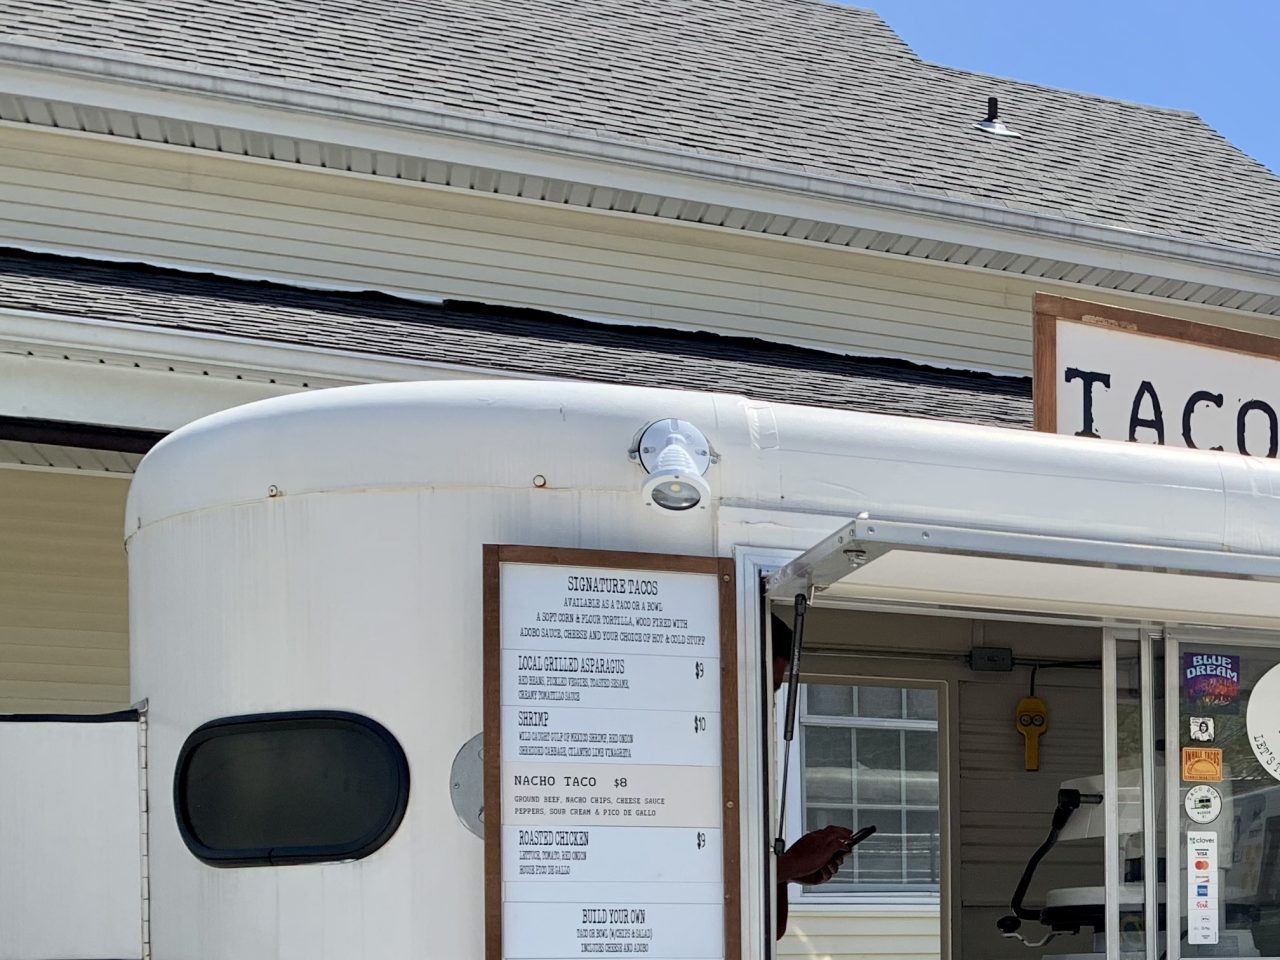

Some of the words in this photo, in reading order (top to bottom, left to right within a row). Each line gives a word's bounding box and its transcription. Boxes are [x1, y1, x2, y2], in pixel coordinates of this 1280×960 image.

[1064, 366, 1279, 459] TACO
[568, 576, 626, 594] SIGNATURE
[628, 579, 658, 596] TACOS
[564, 597, 600, 609] AVAILABLE
[601, 599, 609, 610] AS
[611, 600, 614, 610] A
[616, 600, 631, 610] TACO
[632, 601, 640, 611] OR
[642, 601, 645, 611] A
[647, 601, 663, 612] BOWL
[536, 612, 541, 622] A
[542, 612, 558, 623] SOFT
[558, 613, 574, 623] CORN
[575, 614, 581, 624] &
[581, 614, 601, 625] FLOUR
[602, 615, 634, 626] TORTILLA,
[636, 617, 651, 627] WOOD
[652, 617, 671, 628] FIRED
[672, 618, 688, 629] WITH
[520, 627, 540, 638] ADOBO
[541, 628, 563, 639] SAUCE,
[564, 629, 587, 640] CHEESE
[589, 630, 601, 641] AND
[602, 631, 619, 642] YOUR
[619, 632, 642, 643] CHOICE
[642, 633, 650, 643] OF
[652, 633, 663, 644] HOT
[664, 634, 670, 644] &
[670, 634, 686, 645] COLD
[686, 635, 706, 646] STUFF
[518, 655, 543, 672] LOCAL
[544, 656, 579, 673] GRILLED
[580, 657, 625, 674] ASPARAGUS
[695, 661, 704, 679] $9
[1192, 655, 1232, 668] BLUE
[1186, 665, 1238, 682] DREAM
[518, 711, 549, 727] SHRIMP
[694, 715, 706, 733] $10
[1253, 734, 1276, 766] LET'S
[514, 776, 556, 787] NACHO
[564, 776, 597, 787] TACO
[614, 777, 628, 789] $8
[514, 795, 540, 803] GROUND
[566, 796, 587, 804] NACHO
[616, 797, 641, 805] CHEESE
[644, 797, 665, 805] SAUCE
[550, 808, 566, 816] SOUR
[569, 808, 591, 816] CREAM
[519, 830, 554, 846] ROASTED
[555, 831, 589, 846] CHICKEN
[697, 832, 706, 850] $9
[582, 909, 607, 924] BUILD
[608, 909, 629, 924] YOUR
[630, 909, 645, 924] OWN
